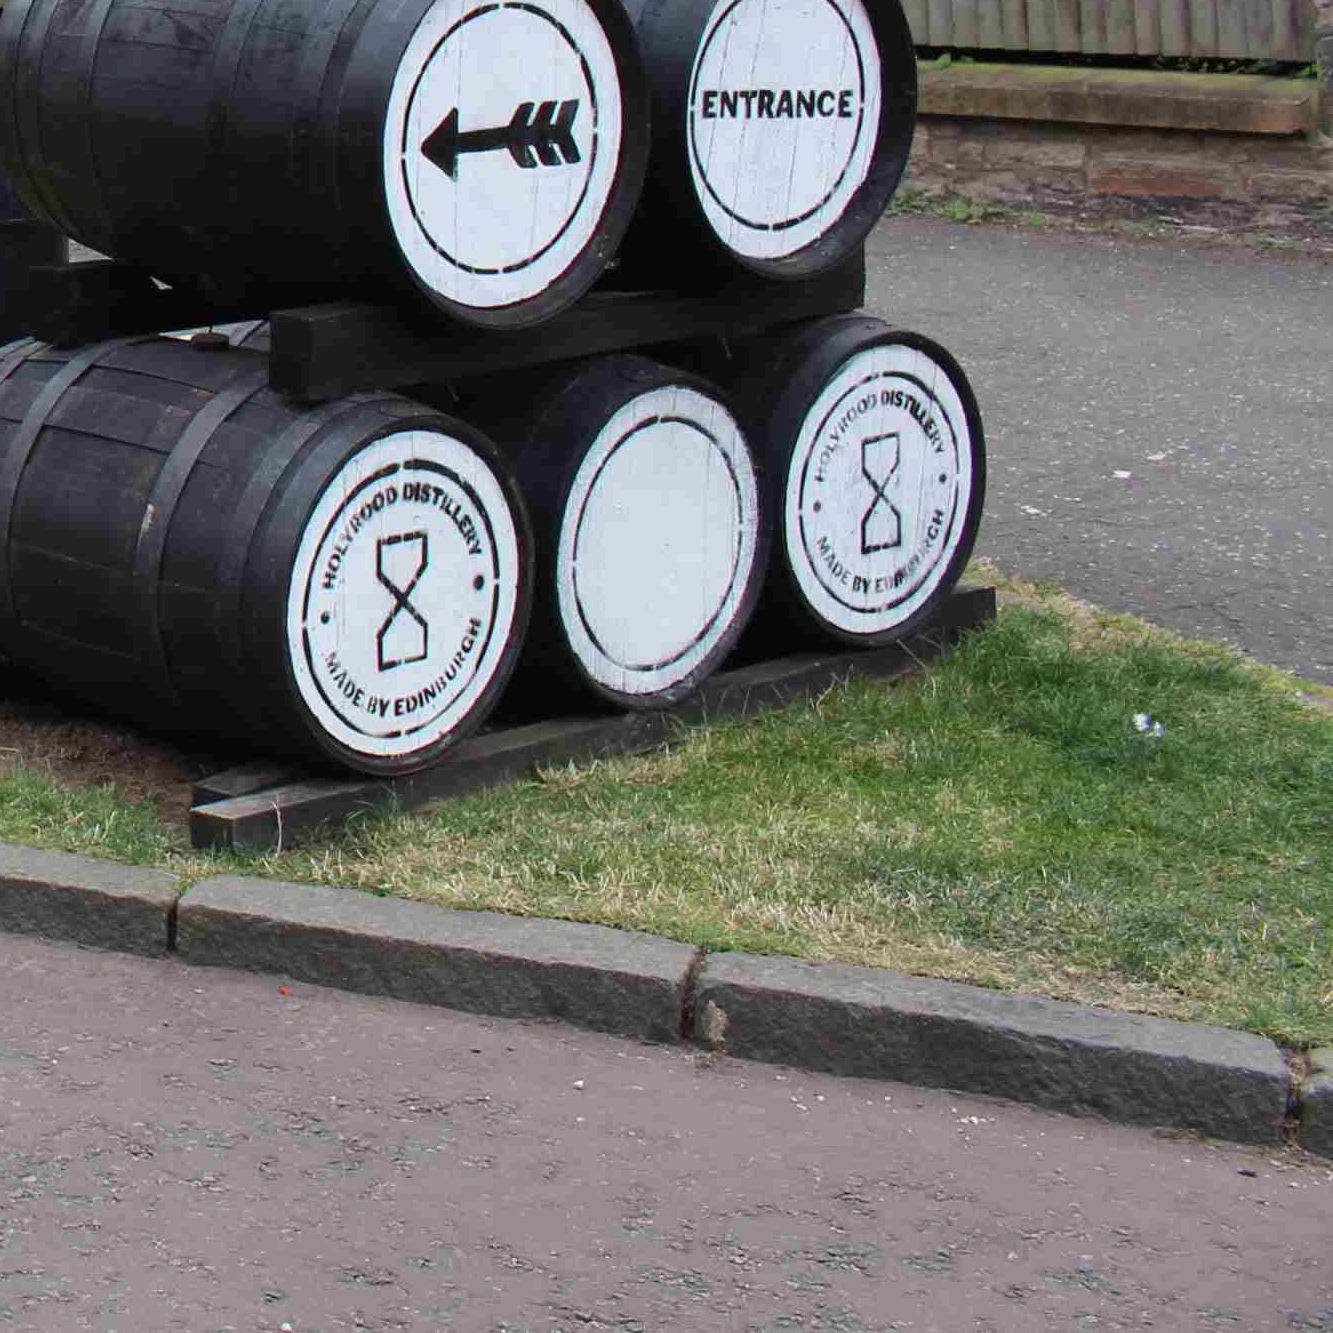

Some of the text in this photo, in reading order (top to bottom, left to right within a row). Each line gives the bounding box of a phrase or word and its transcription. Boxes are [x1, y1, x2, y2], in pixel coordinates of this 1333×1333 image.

[702, 90, 853, 119] ENTRANCE
[814, 389, 944, 482] HOLYROOD DISTILLERY
[322, 481, 482, 589] HOLYROOD DISTILLERY
[817, 536, 852, 585] MADE
[853, 574, 871, 594] BY
[324, 617, 481, 717] MADE BY EDINBURGH
